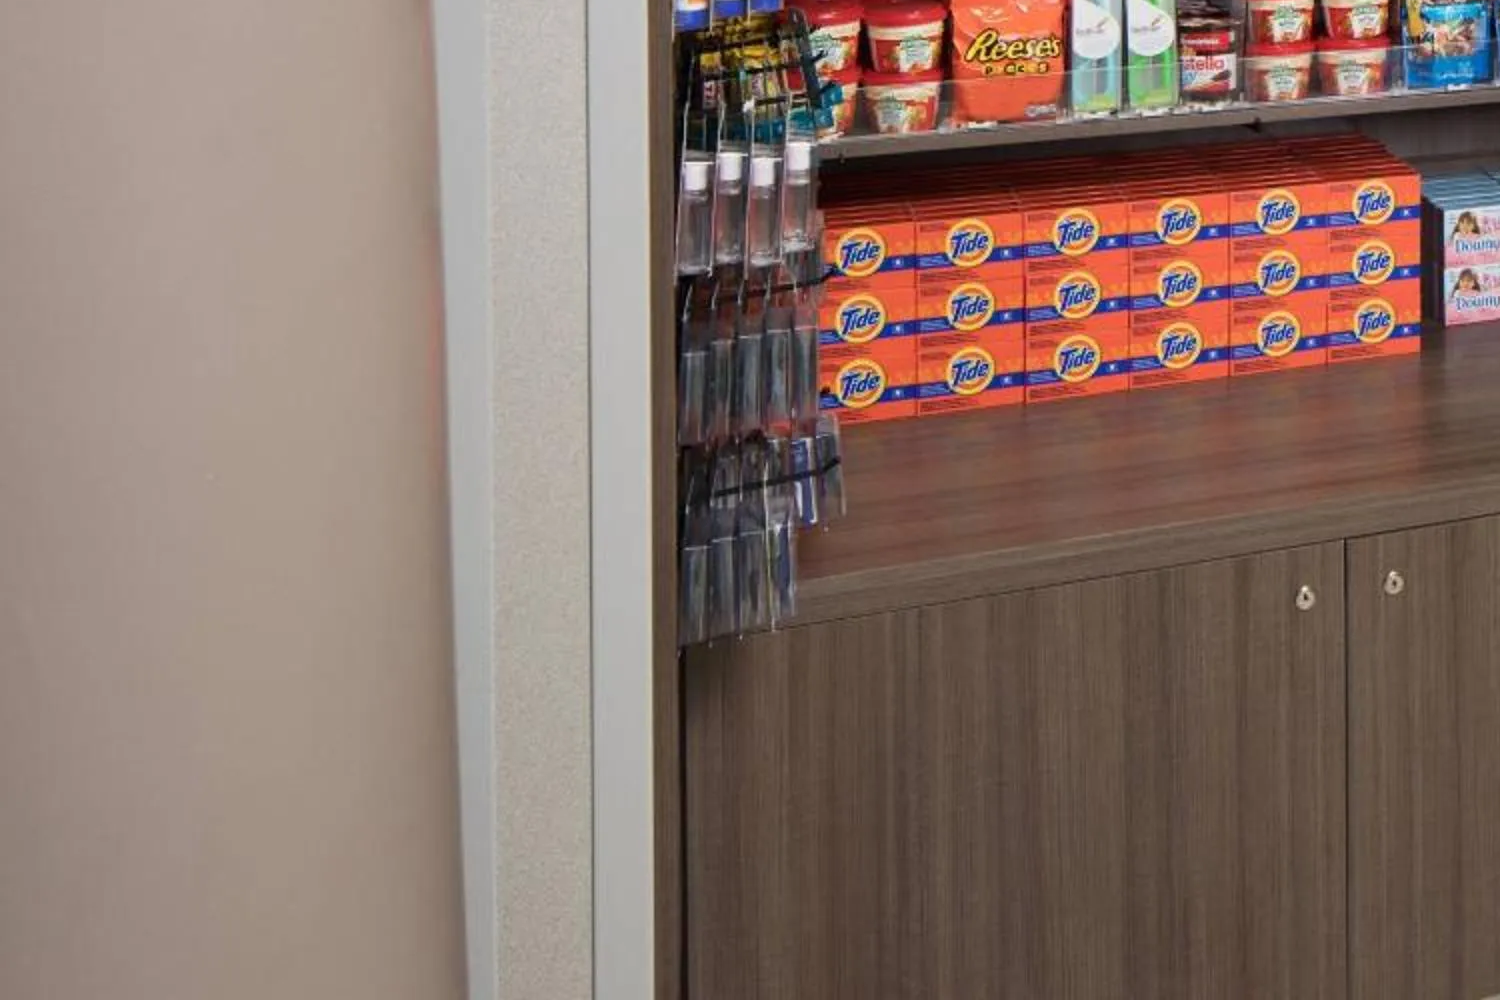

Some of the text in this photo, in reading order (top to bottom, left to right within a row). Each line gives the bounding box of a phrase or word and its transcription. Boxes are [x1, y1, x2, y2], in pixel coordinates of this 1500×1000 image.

[964, 29, 1061, 62] Reese's
[1261, 199, 1296, 227] Tide
[1357, 190, 1392, 217] Tide
[1057, 219, 1096, 247] Tide
[1162, 209, 1197, 237] Tide
[841, 243, 880, 269] Tide
[951, 230, 990, 258] Tide
[1261, 260, 1296, 288] Tide
[1357, 251, 1392, 276] Tide
[1058, 284, 1097, 311] Tide
[1162, 271, 1197, 299] Tide
[841, 308, 881, 335] Tide
[951, 296, 990, 323] Tide
[1358, 310, 1392, 336] Tide
[1162, 333, 1197, 361] Tide
[1261, 322, 1296, 349] Tide
[951, 360, 990, 387] Tide
[1058, 347, 1096, 375] Tide
[841, 373, 881, 400] Tide
